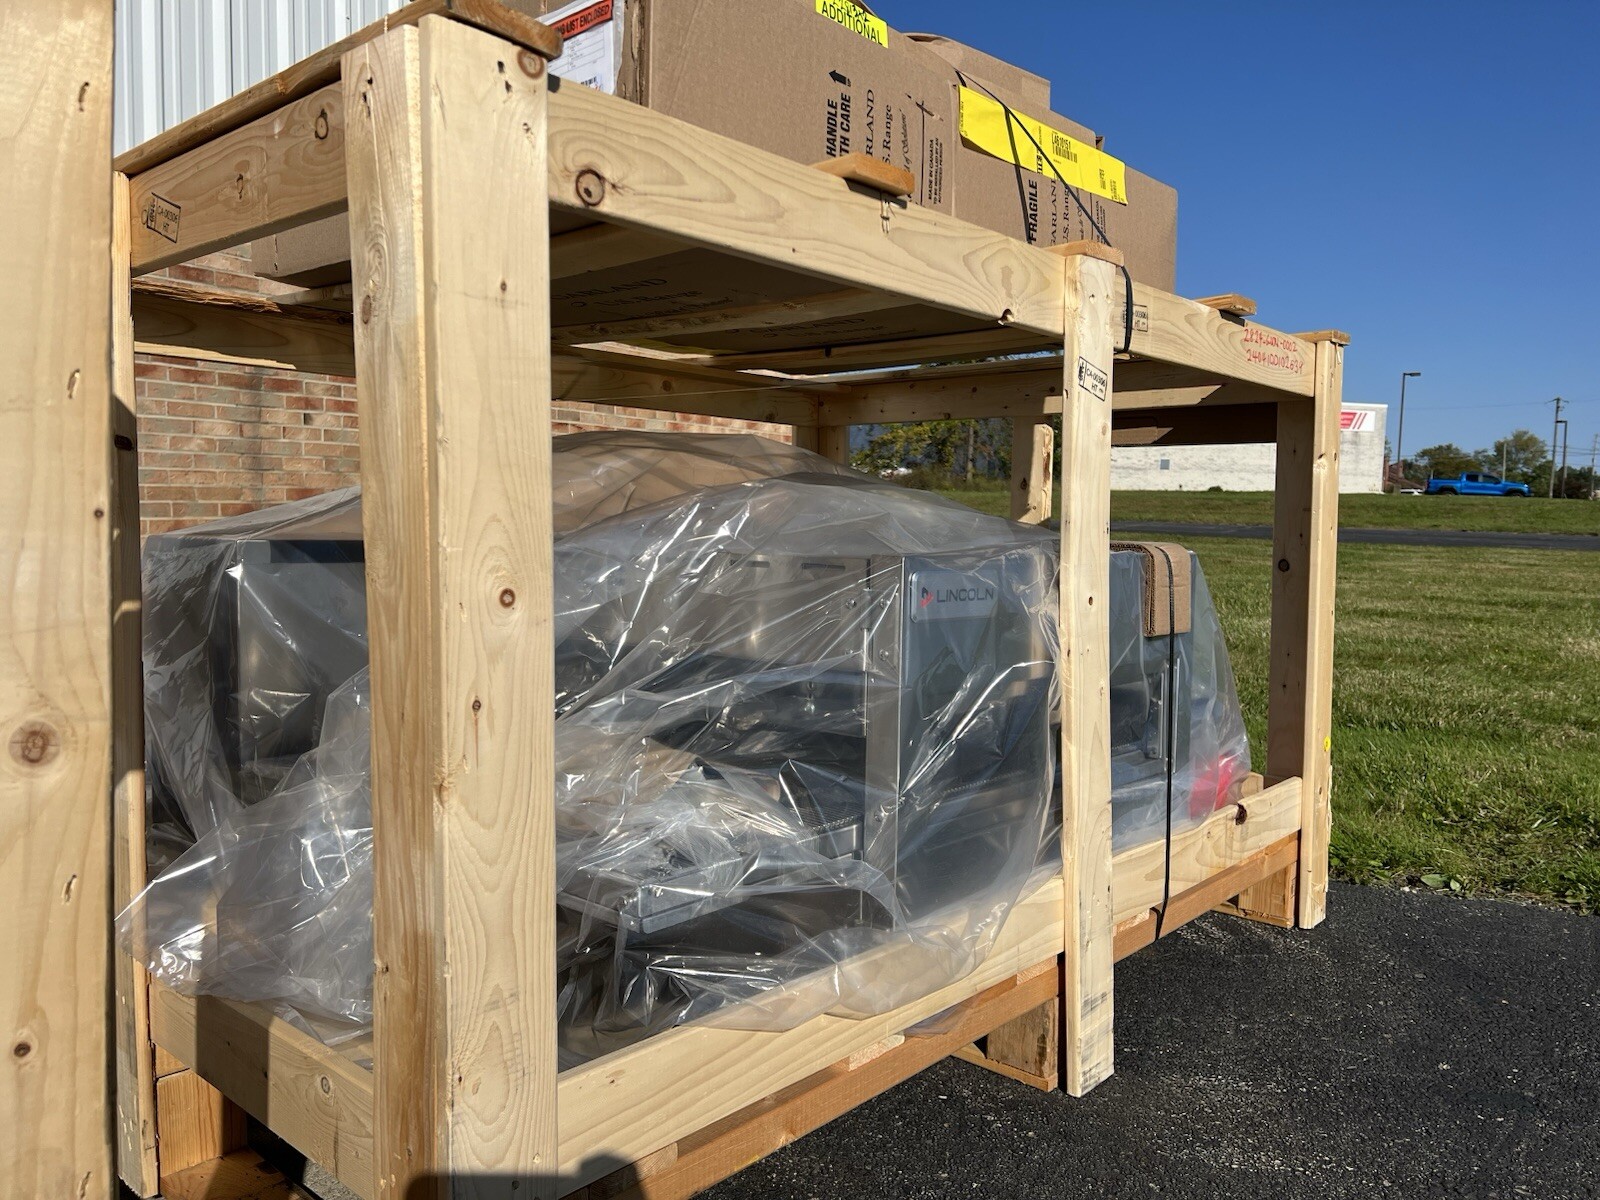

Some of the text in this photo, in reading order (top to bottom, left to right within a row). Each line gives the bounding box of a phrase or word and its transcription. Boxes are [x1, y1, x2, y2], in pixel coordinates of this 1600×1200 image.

[566, 19, 579, 33] LIST
[580, 5, 610, 28] ENCLOSED
[821, 1, 883, 46] ADDITIONAL
[826, 98, 838, 158] HANDLE
[839, 92, 851, 157] TH CARE
[866, 89, 876, 157] RLAND
[883, 104, 893, 151] Range
[1028, 179, 1038, 242] FRAGILE
[936, 588, 994, 603] LINCOLN
